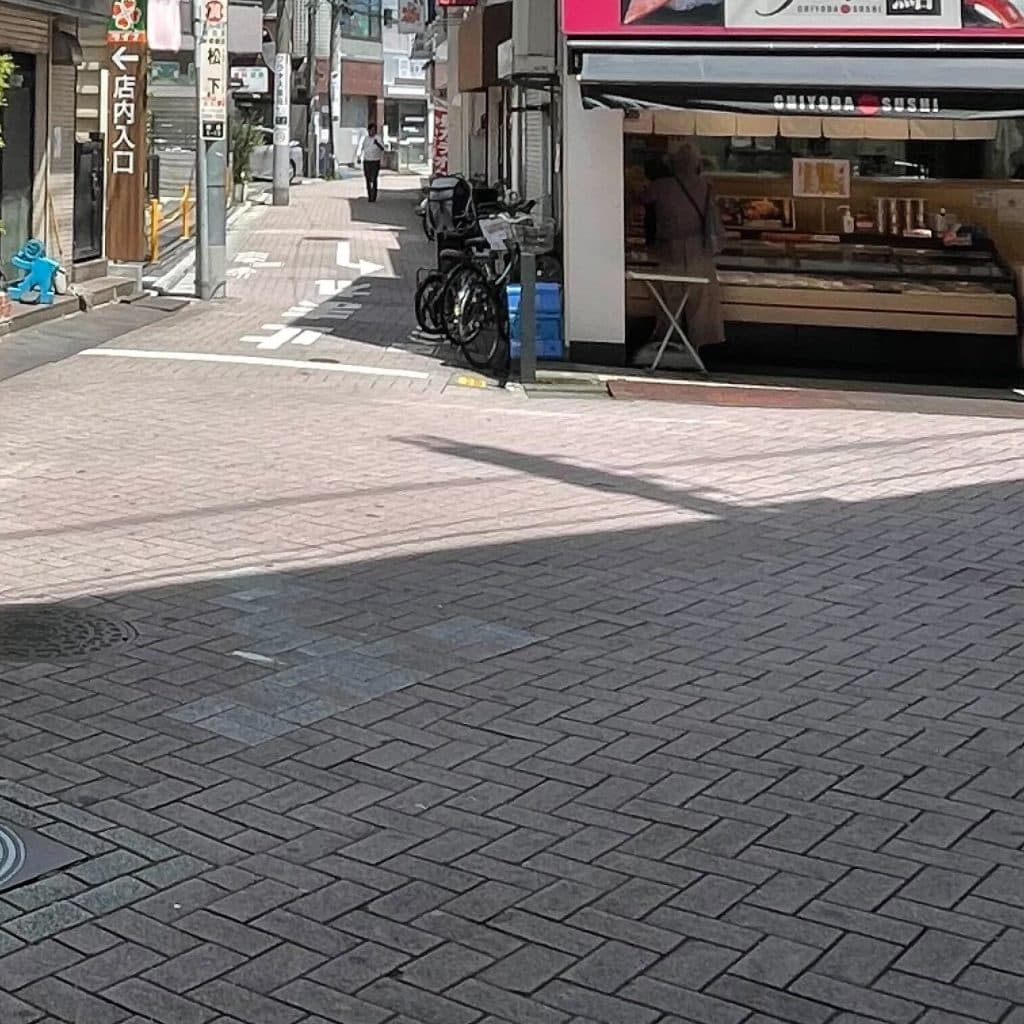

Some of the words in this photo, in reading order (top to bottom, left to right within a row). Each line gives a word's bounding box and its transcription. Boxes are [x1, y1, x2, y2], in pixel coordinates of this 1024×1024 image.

[112, 73, 136, 175] 店内入口
[773, 94, 855, 111] CHIYODA
[881, 96, 939, 113] SUSHI
